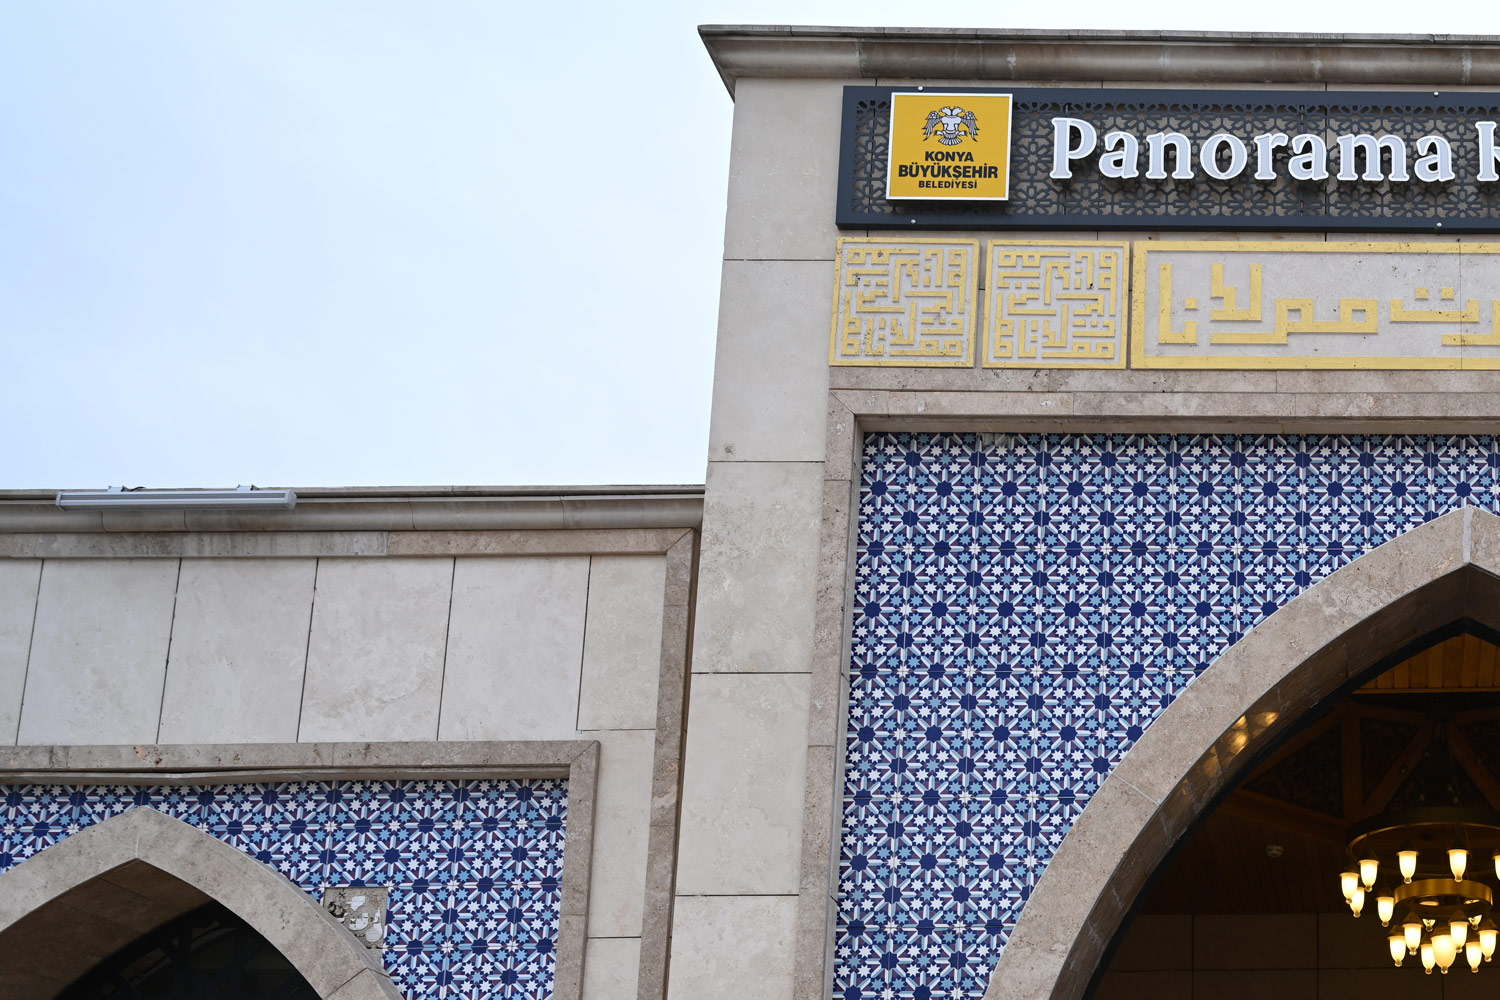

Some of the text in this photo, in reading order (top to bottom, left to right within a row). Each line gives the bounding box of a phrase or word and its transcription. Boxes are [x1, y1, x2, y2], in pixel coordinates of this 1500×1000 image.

[924, 151, 974, 162] KONYA
[1049, 116, 1456, 183] Panorama
[898, 162, 998, 180] BÜYÜKŞEHİR
[918, 179, 978, 189] BELEDİYESİ
